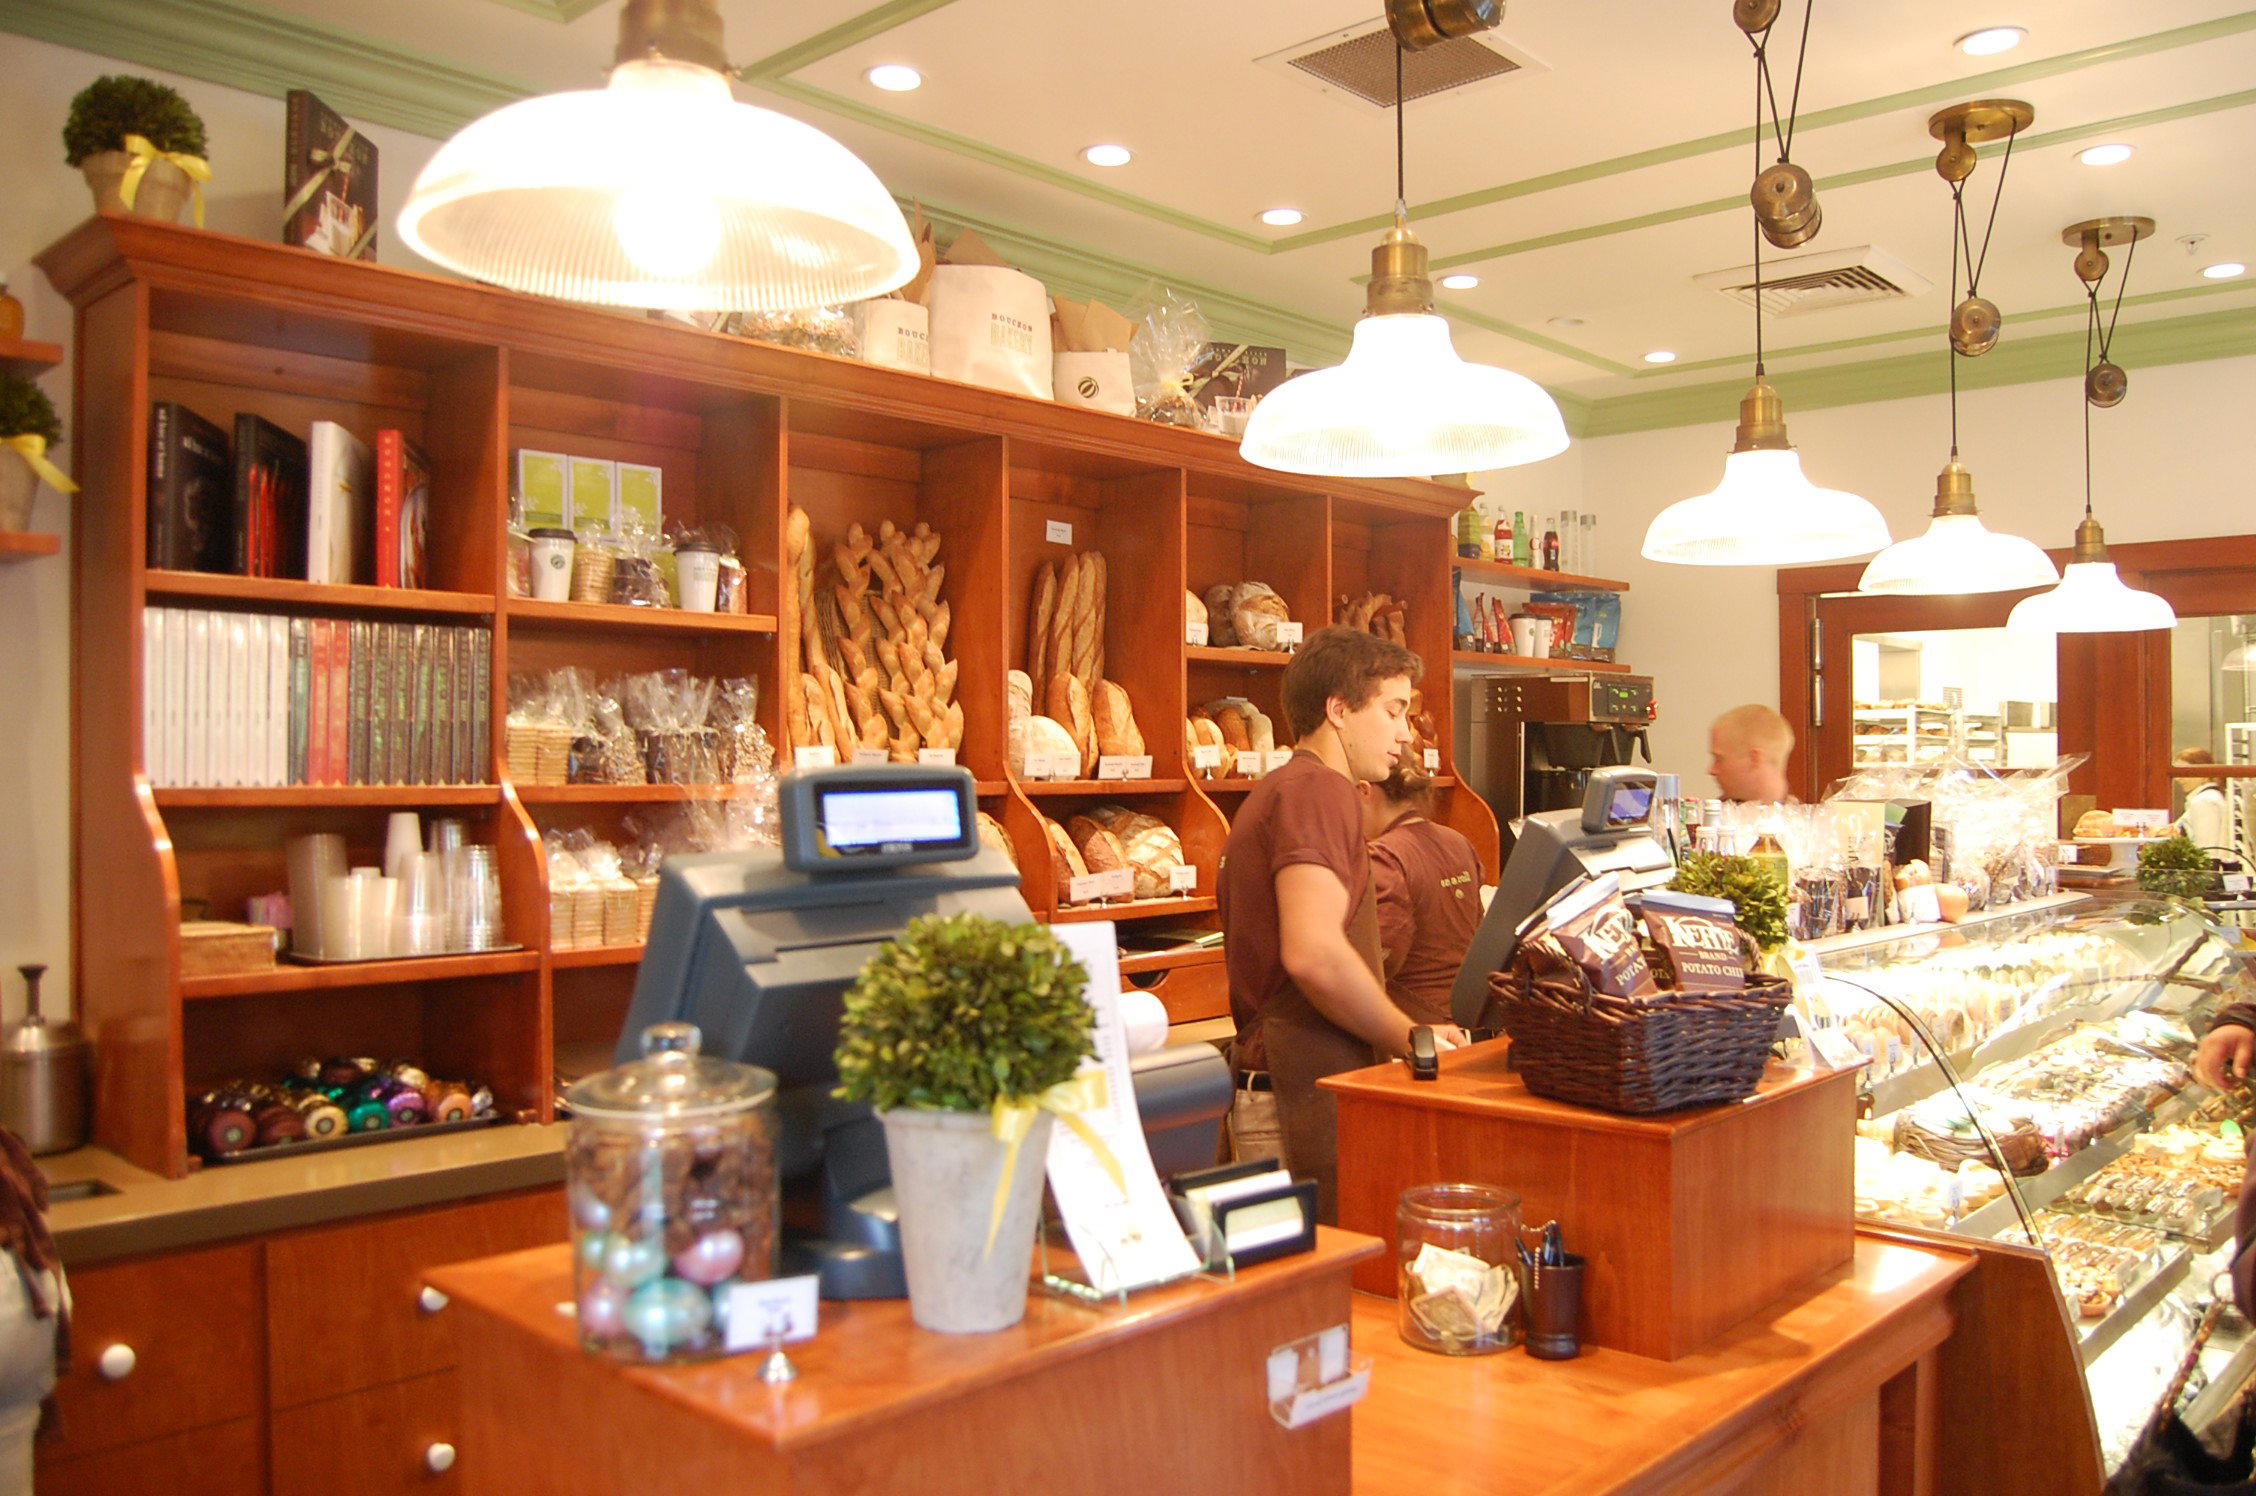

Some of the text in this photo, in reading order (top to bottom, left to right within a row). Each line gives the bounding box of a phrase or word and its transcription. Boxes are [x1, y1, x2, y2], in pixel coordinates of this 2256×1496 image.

[990, 311, 1033, 332] BOUCHON
[1697, 950, 1728, 961] BRAND
[1681, 961, 1721, 976] POTATO
